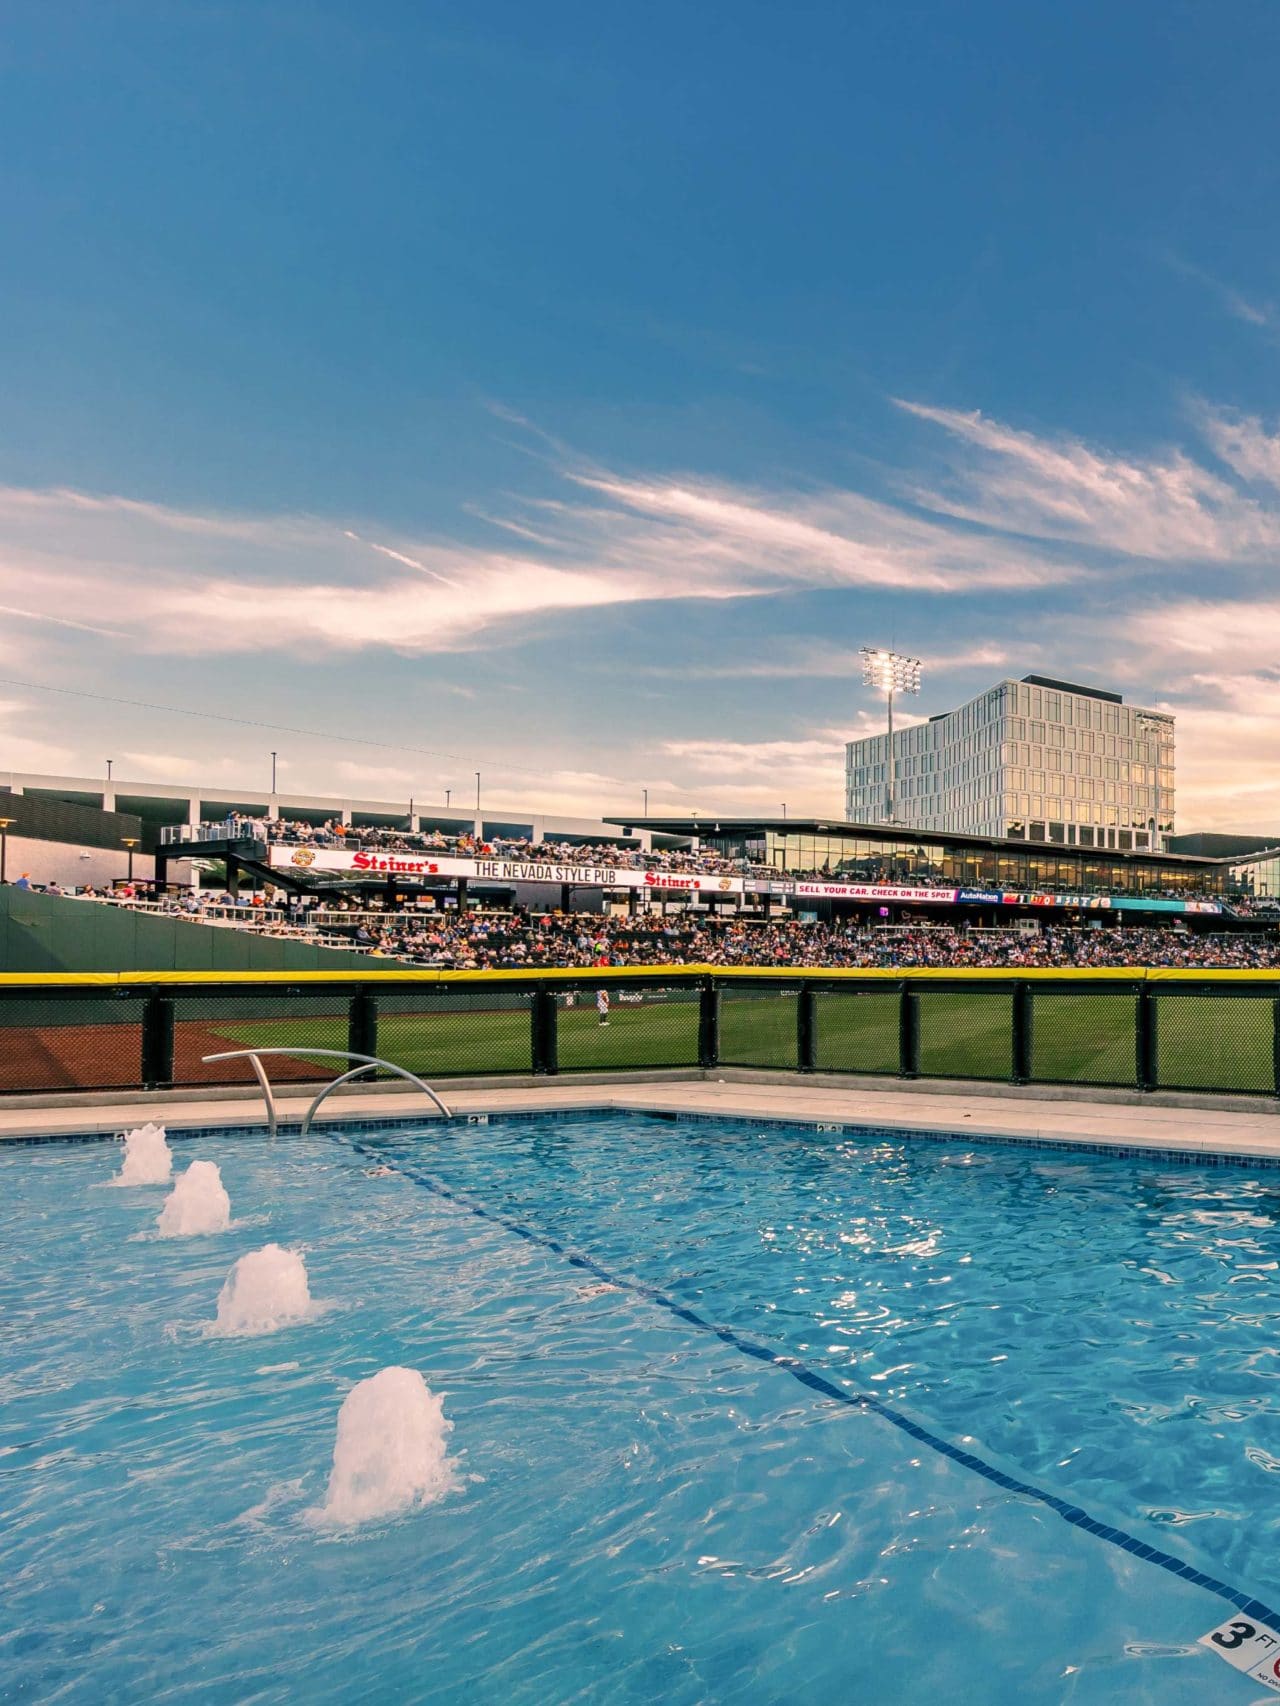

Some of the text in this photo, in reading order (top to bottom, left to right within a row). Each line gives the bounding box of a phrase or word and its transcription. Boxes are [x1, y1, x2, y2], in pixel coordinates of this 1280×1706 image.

[351, 852, 438, 873] Steiner's
[474, 861, 616, 884] THE NEVADA STYLE PUB
[643, 871, 700, 889] Steiner's
[799, 885, 952, 899] SELL YOUR CAR. CHECK ON THE SPOT.
[960, 891, 998, 901] AutoNation
[1211, 1622, 1278, 1649] 3 FT
[1257, 1672, 1269, 1681] NO
